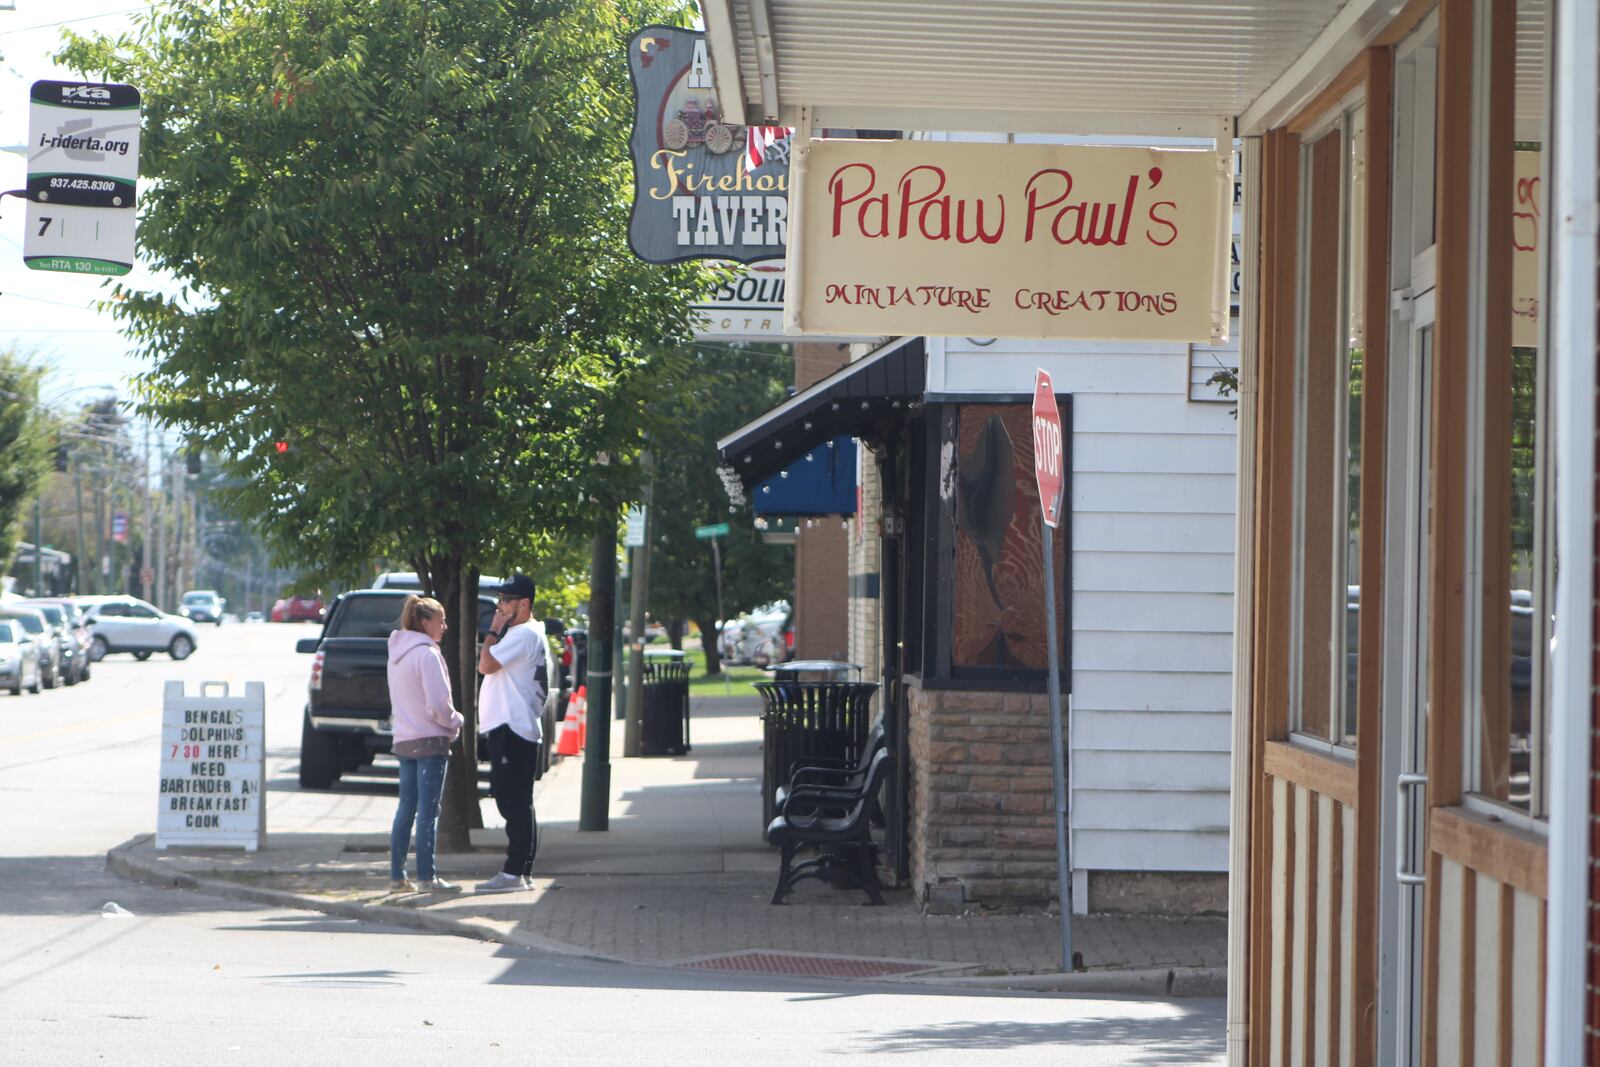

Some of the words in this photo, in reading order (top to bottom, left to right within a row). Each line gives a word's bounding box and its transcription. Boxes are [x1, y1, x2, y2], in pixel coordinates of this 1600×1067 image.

[62, 86, 111, 99] rta
[39, 133, 129, 155] i-riderta.org
[50, 177, 115, 191] 937.425.8300
[828, 162, 1005, 244] PaPaw
[1024, 166, 1178, 246] Paul's
[37, 216, 52, 237] 7
[51, 259, 71, 270] RTA
[74, 261, 91, 272] 130
[825, 283, 991, 313] MINIATURE
[1014, 288, 1178, 316] CREATIONS
[1036, 415, 1060, 477] STOP
[184, 709, 243, 724] BENGALS
[181, 728, 244, 742] DOLPHINS
[191, 762, 225, 776] NEED
[160, 778, 231, 793] BARTENDER
[241, 780, 258, 794] AN
[186, 814, 219, 828] COOK
